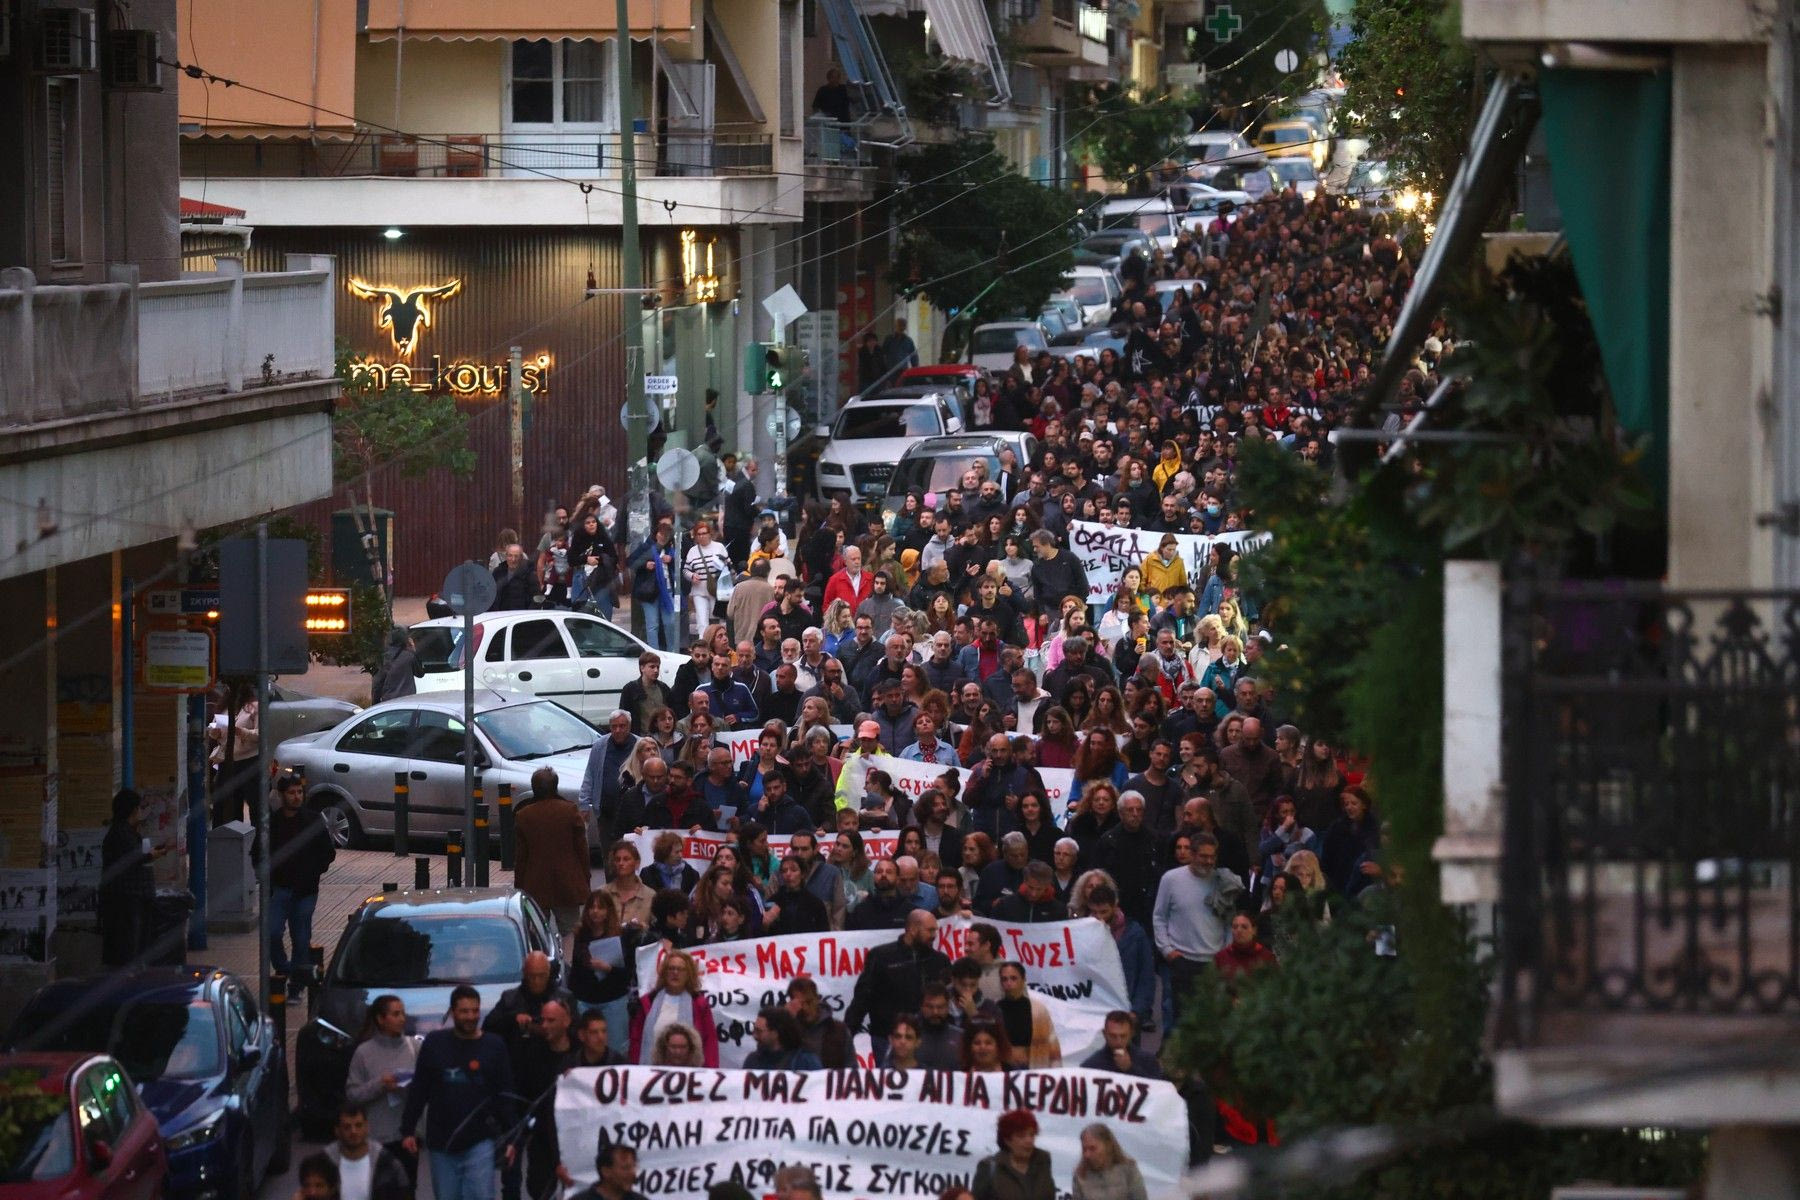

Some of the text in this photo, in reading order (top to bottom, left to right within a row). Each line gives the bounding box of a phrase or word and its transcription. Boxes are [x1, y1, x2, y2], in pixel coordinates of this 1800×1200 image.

[349, 354, 548, 393] me_kousi
[1075, 524, 1149, 563] ΦΩΤΙΑ
[819, 938, 869, 977] ΠΑΝ
[595, 1068, 629, 1105] ΟΙ
[744, 1070, 809, 1104] ΜΑΣ
[826, 1067, 908, 1101] ΠΑΝΩ
[1003, 1071, 1087, 1118] ΚΕΡΔΗ
[598, 1116, 971, 1156] ΑΣΦΑΛΗ ΣΠΙΤΙΑ ΓΙΑ ΟΛΟΥΣ/ΕΣ
[635, 1159, 971, 1196] ΜΟΣΙΕΣ ΑΣΦΕΙΣ ΣΥΓΚΟΙΝ
